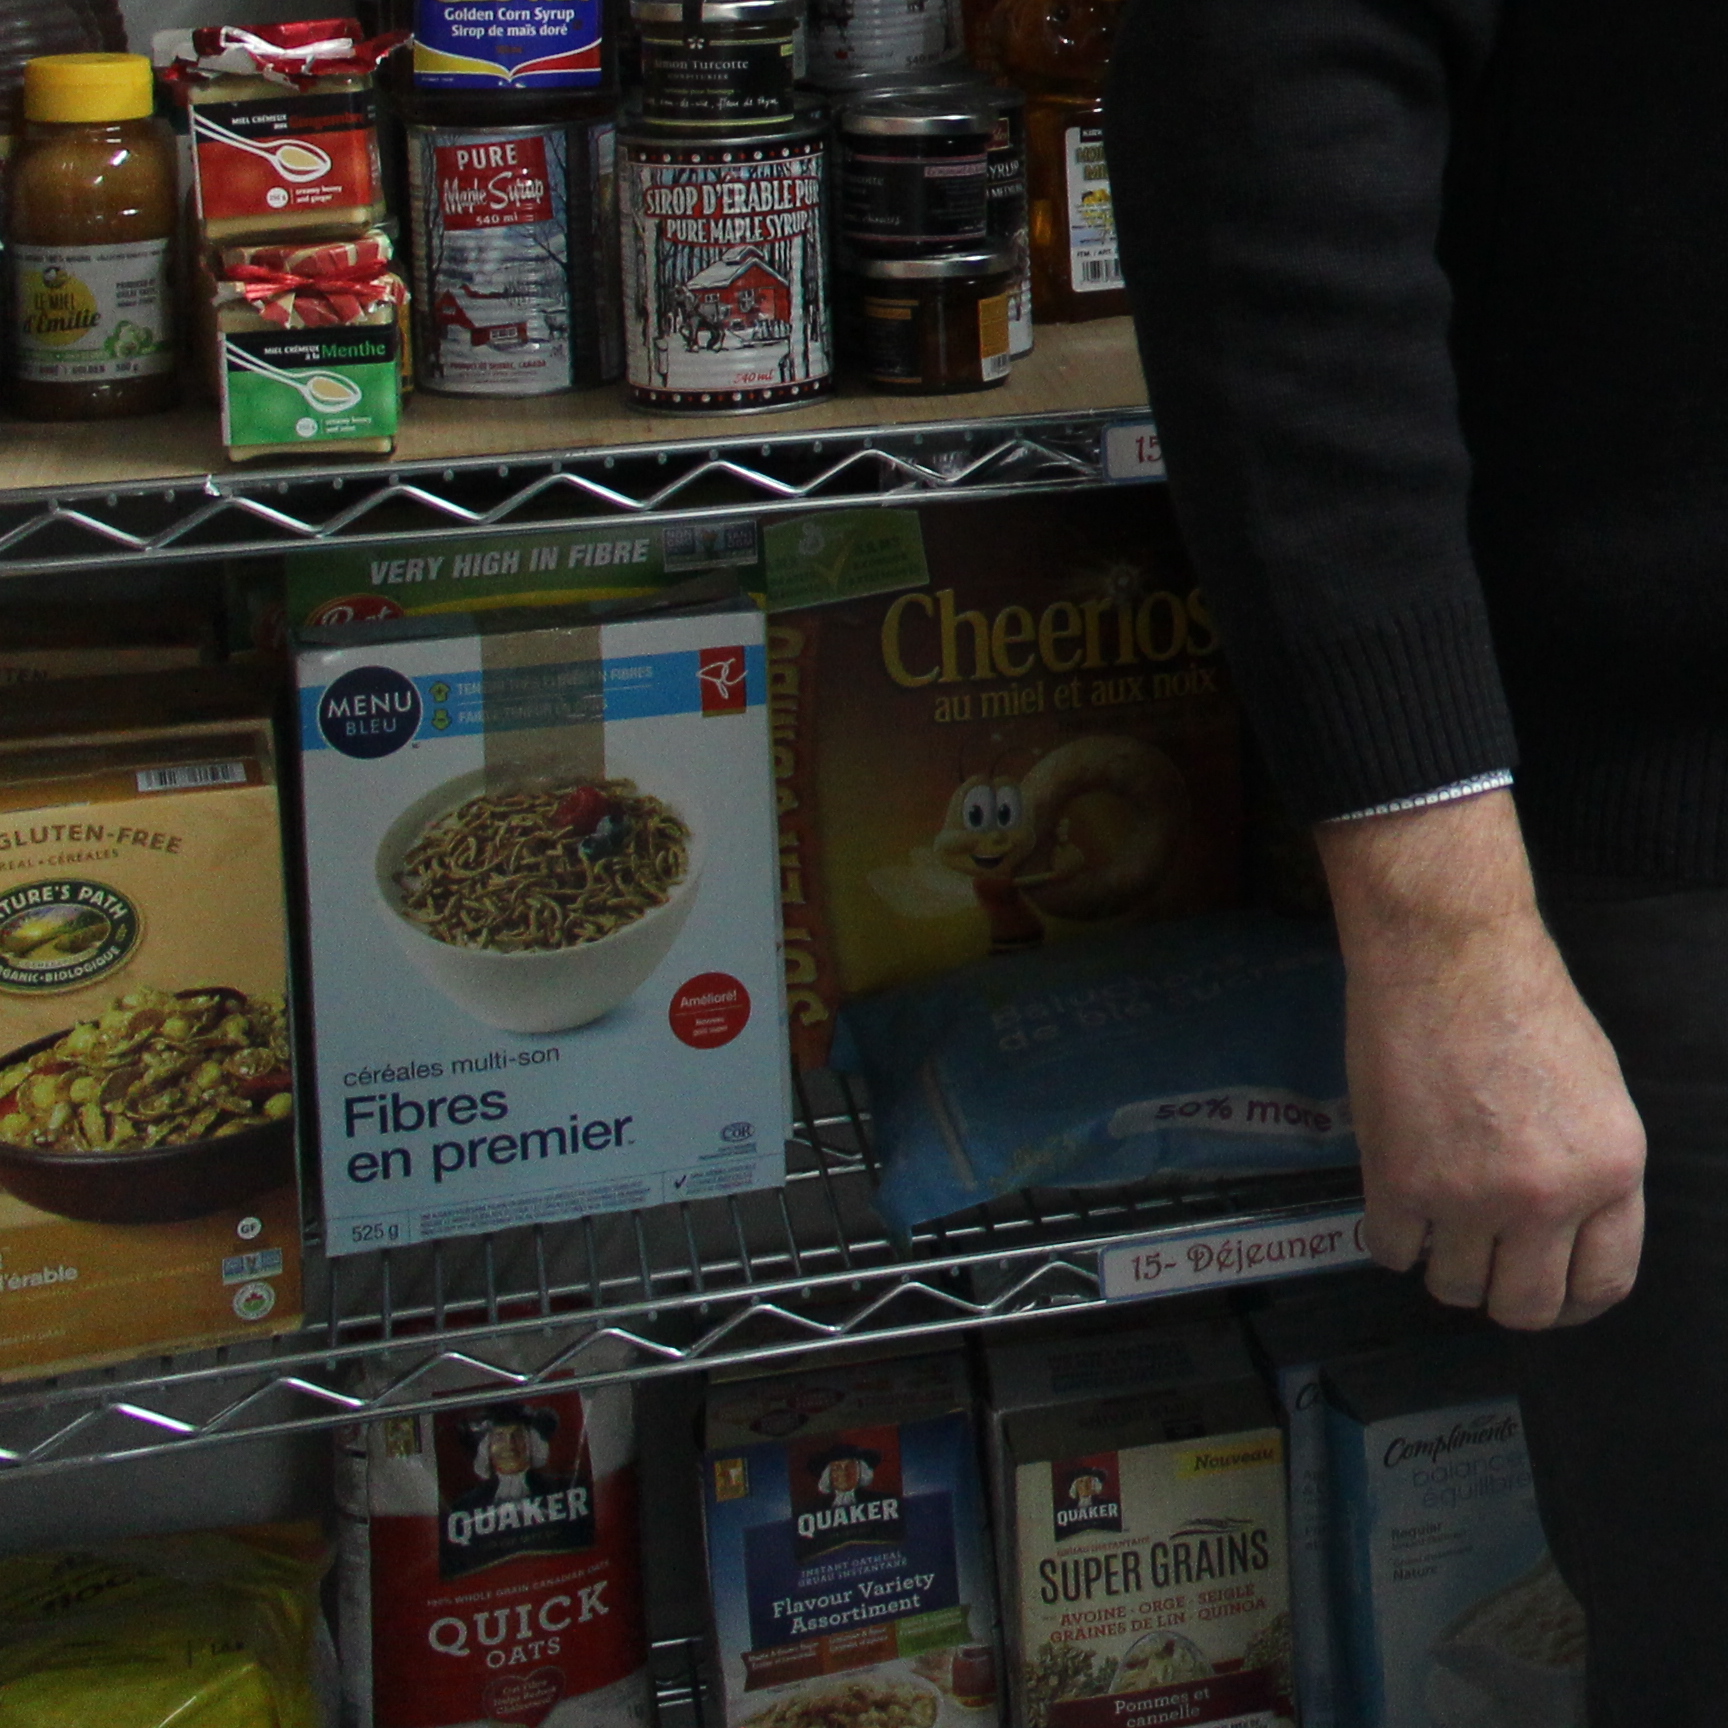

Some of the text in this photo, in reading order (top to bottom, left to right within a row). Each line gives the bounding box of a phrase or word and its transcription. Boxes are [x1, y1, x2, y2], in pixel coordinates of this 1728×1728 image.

[443, 6, 575, 24] Golden Corn Syrup
[451, 22, 567, 39] Sirop de maïs doré
[456, 142, 518, 172] PURE
[443, 172, 545, 216] Maple Syrup
[645, 192, 698, 217] SIROP
[666, 216, 808, 244] PURE MAPLE SYRUP
[321, 340, 386, 358] Menthe
[369, 539, 650, 587] VERY HIGH IN FIBRE
[881, 586, 1222, 692] Cheerios
[327, 691, 414, 719] MENU
[981, 664, 1217, 716] miel et aux noix
[345, 718, 398, 737] BLEU
[680, 990, 738, 1009] Amélioré!
[343, 1046, 560, 1088] céréales multi-son
[344, 1090, 509, 1139] Fibres
[1154, 1095, 1333, 1132] 50% more
[347, 1114, 633, 1184] en premier
[352, 1223, 385, 1243] 525
[1131, 1228, 1343, 1283] 15- Déjeuner
[1194, 1446, 1274, 1472] Nouveau
[1383, 1415, 1522, 1471] Compliments
[446, 1484, 589, 1547] QUAKER
[797, 1498, 900, 1539] QUAKER
[1056, 1501, 1119, 1527] QUAKER
[1039, 1530, 1269, 1604] SUPER GRAINS
[772, 1572, 936, 1620] Flavour Variety
[789, 1593, 922, 1636] Assortiment
[427, 1580, 611, 1658] QUICK
[1050, 1597, 1266, 1645] GRAINES DE LIN QUINOA
[1060, 1605, 1126, 1627] AVOINE
[486, 1634, 562, 1670] OATS
[1113, 1688, 1211, 1716] Pommes et
[1126, 1704, 1200, 1728] cannelle
